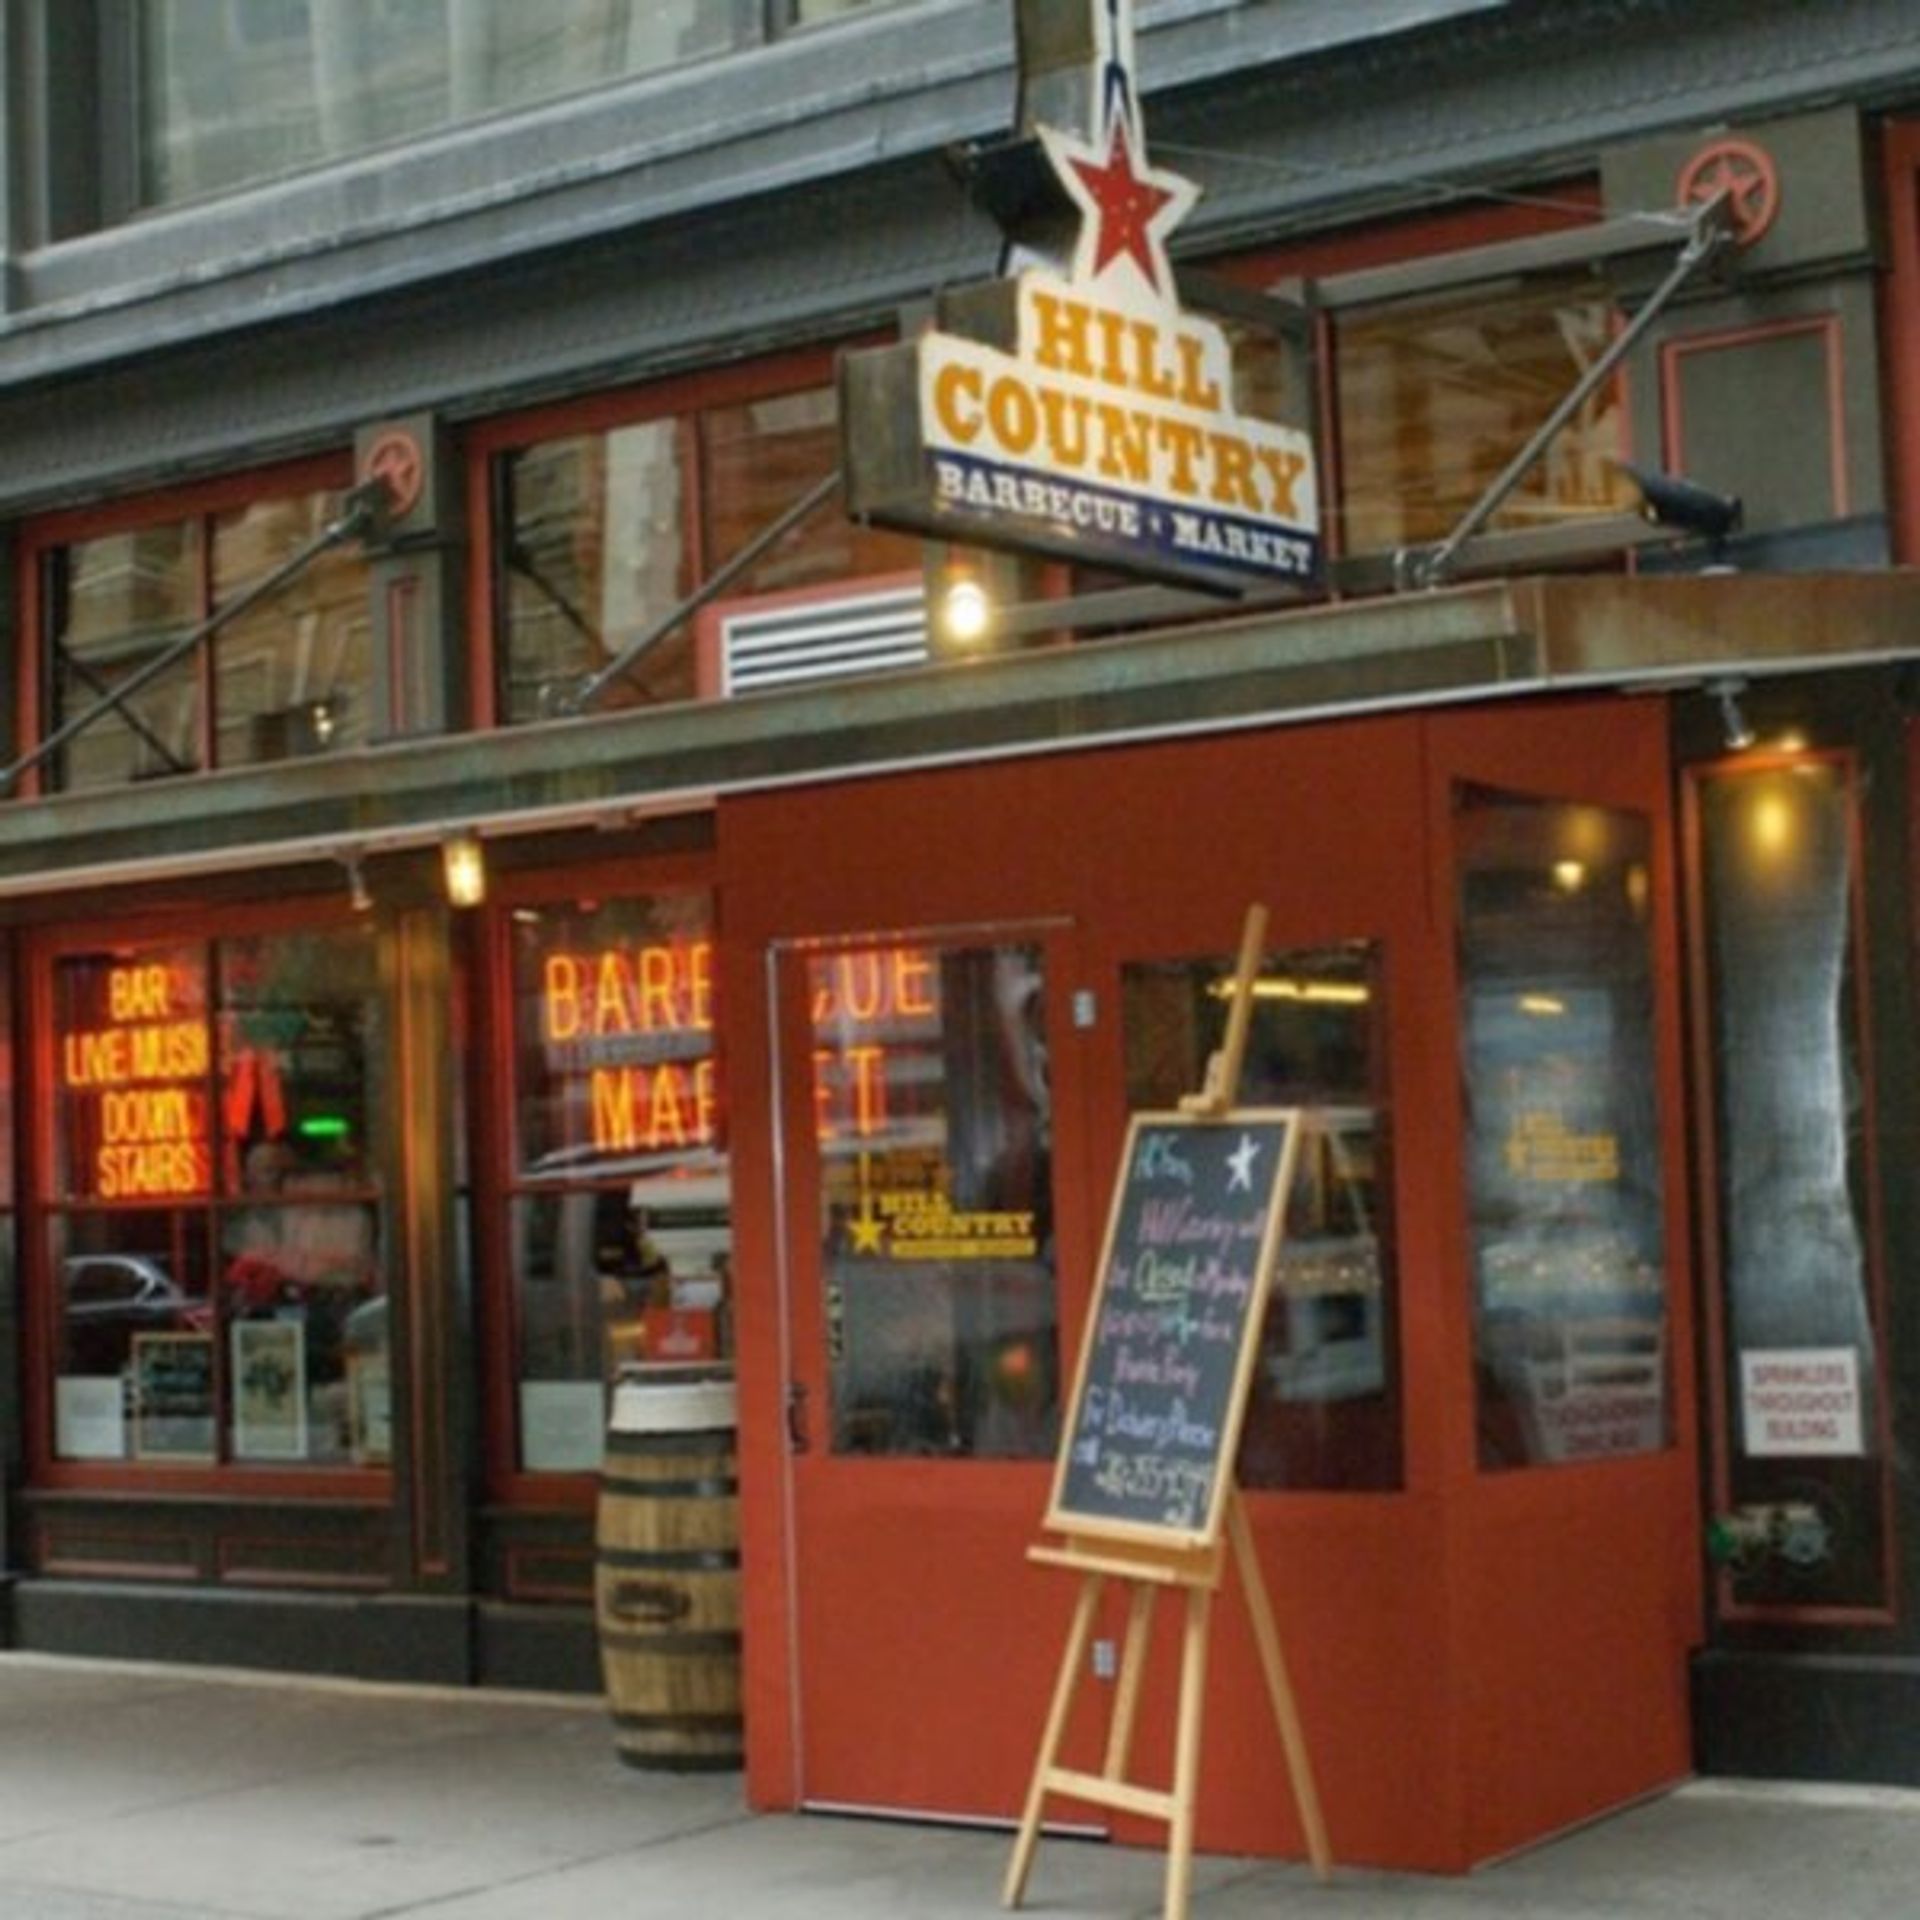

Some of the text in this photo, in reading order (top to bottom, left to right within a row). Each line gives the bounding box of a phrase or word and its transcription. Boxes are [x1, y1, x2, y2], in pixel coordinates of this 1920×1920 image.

[1032, 292, 1221, 412] HILL
[933, 362, 1308, 518] COUNTRY
[935, 462, 1312, 574] BARBECUE MARKET
[109, 965, 169, 1021] BAR
[65, 1028, 131, 1086] LIVE
[102, 1088, 191, 1144] DOWN
[98, 1142, 199, 1198] STAIRS
